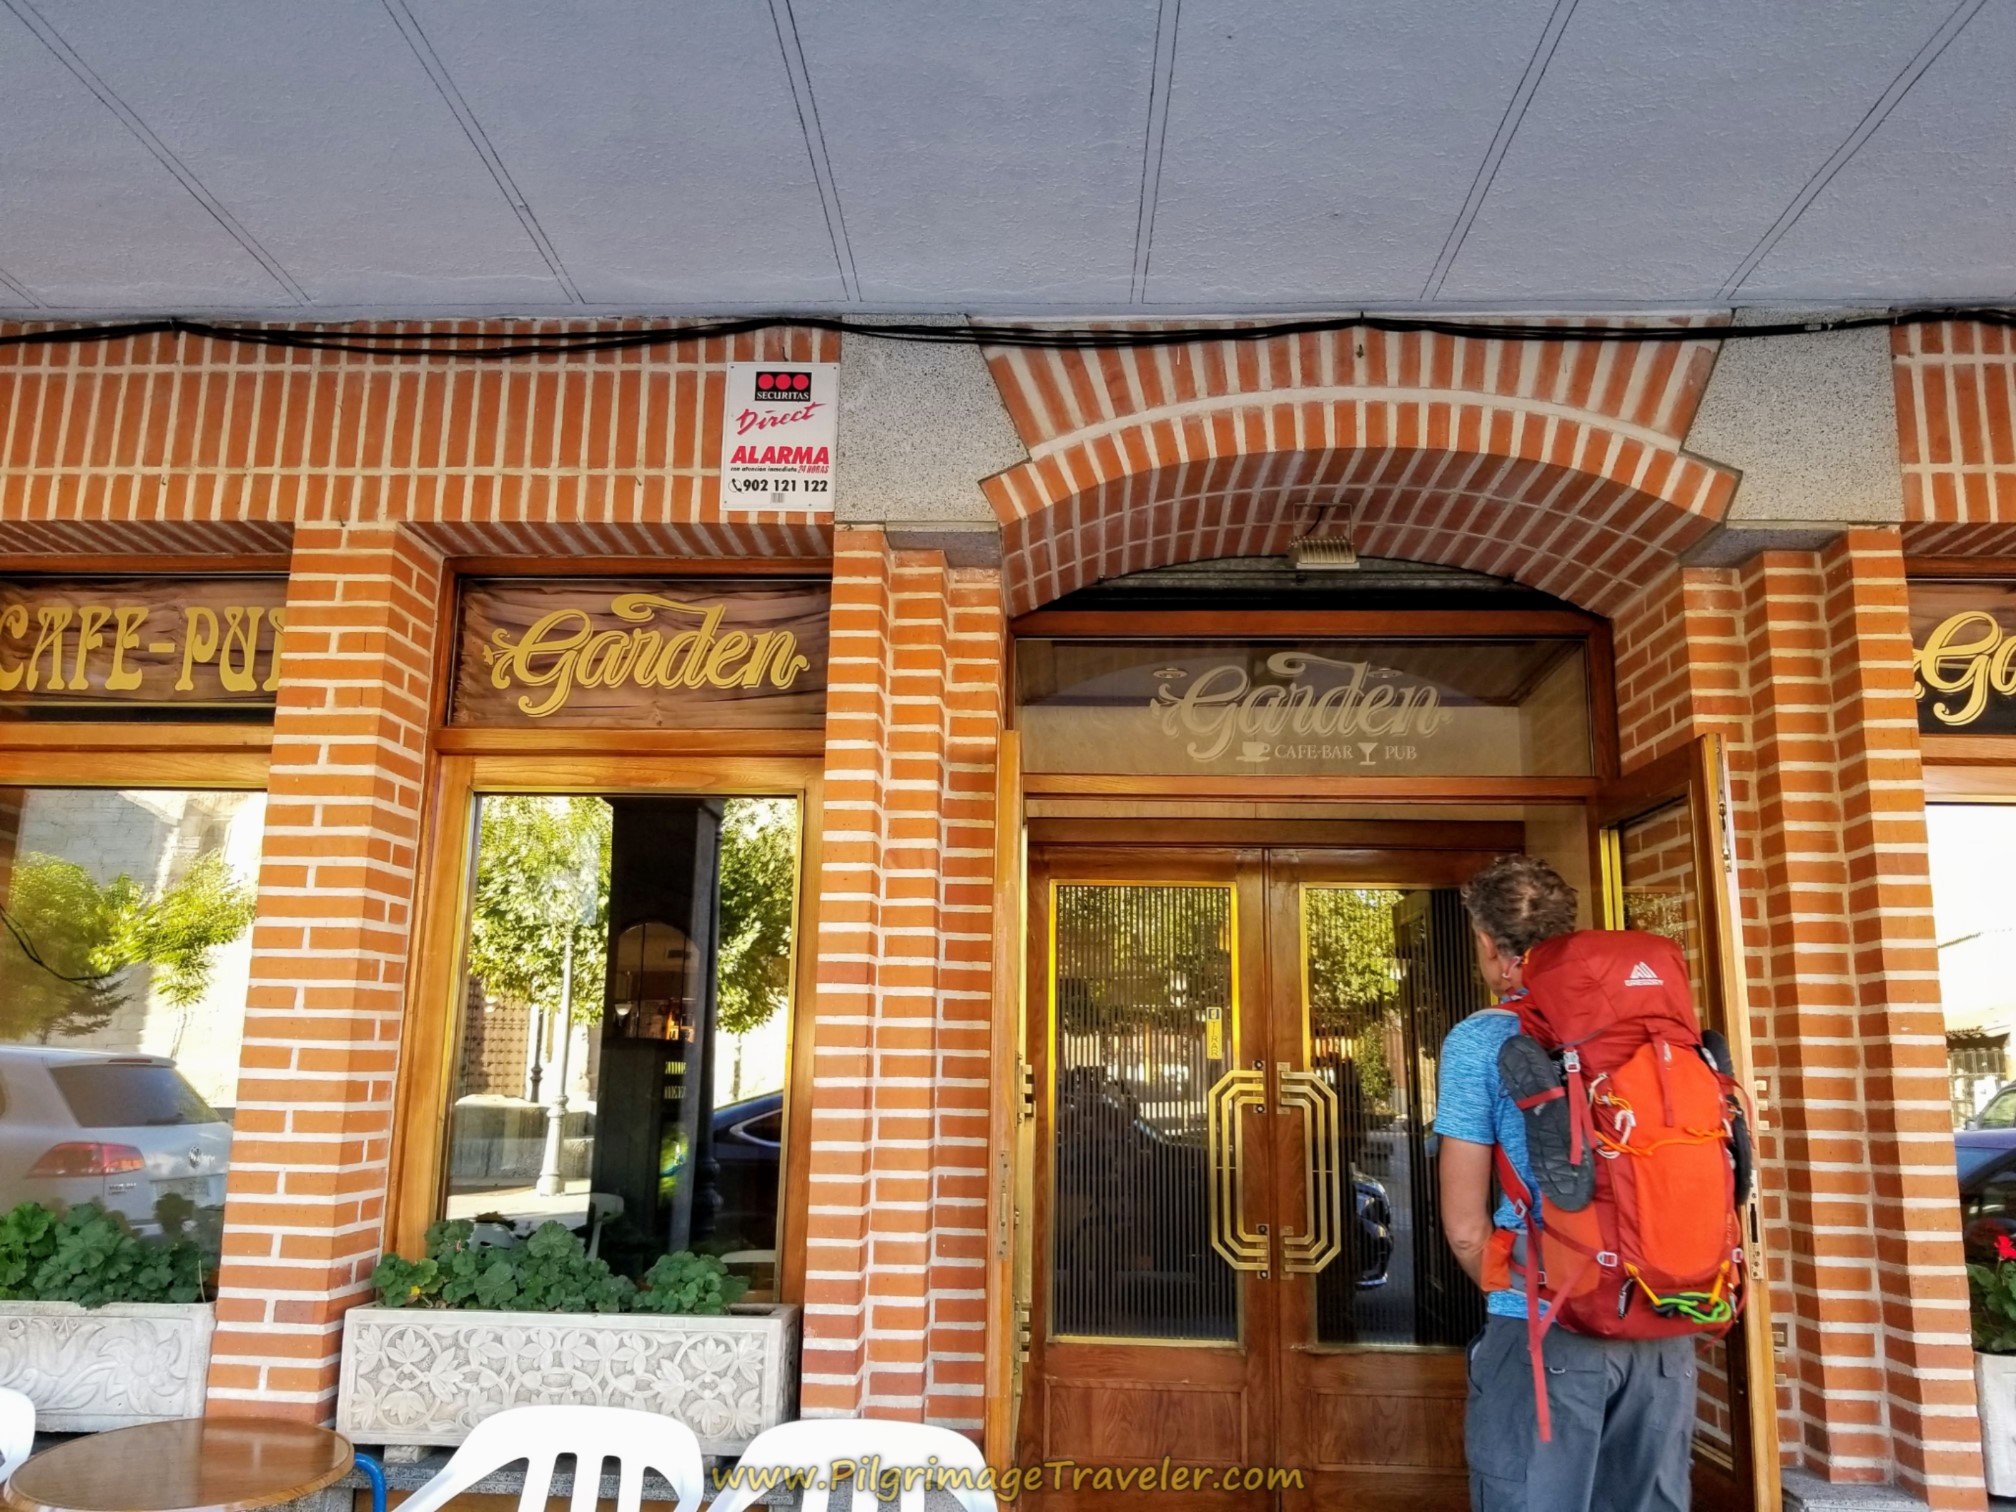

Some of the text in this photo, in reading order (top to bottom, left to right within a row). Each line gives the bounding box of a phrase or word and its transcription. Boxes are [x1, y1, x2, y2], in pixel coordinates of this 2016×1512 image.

[757, 391, 809, 399] SECURITAS
[736, 402, 827, 435] Direct
[730, 446, 829, 465] ALARMA
[806, 465, 830, 474] HORAS
[743, 479, 828, 493] 902 121 122
[482, 593, 811, 718] Garden
[1150, 651, 1454, 762] Garden
[1384, 745, 1417, 760] PUB
